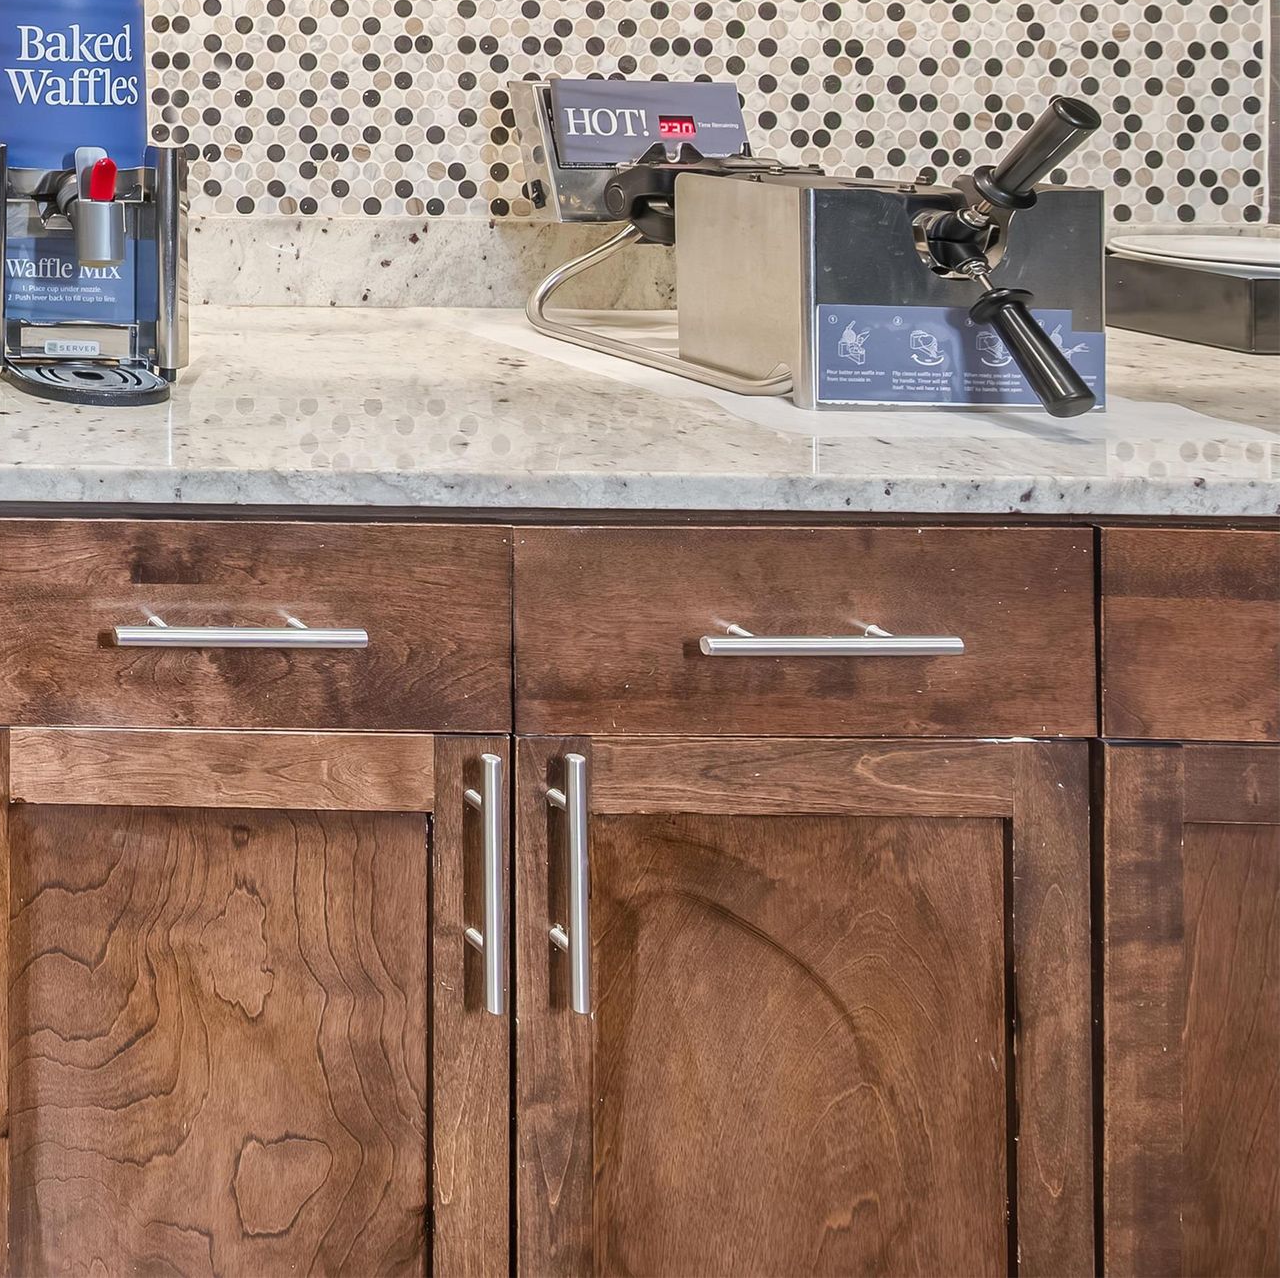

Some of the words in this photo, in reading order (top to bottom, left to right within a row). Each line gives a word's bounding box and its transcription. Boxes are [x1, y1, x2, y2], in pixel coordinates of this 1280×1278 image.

[16, 24, 133, 62] Baked
[4, 67, 138, 106] Waffles
[564, 108, 650, 137] HOT!
[5, 257, 73, 278] Waffle
